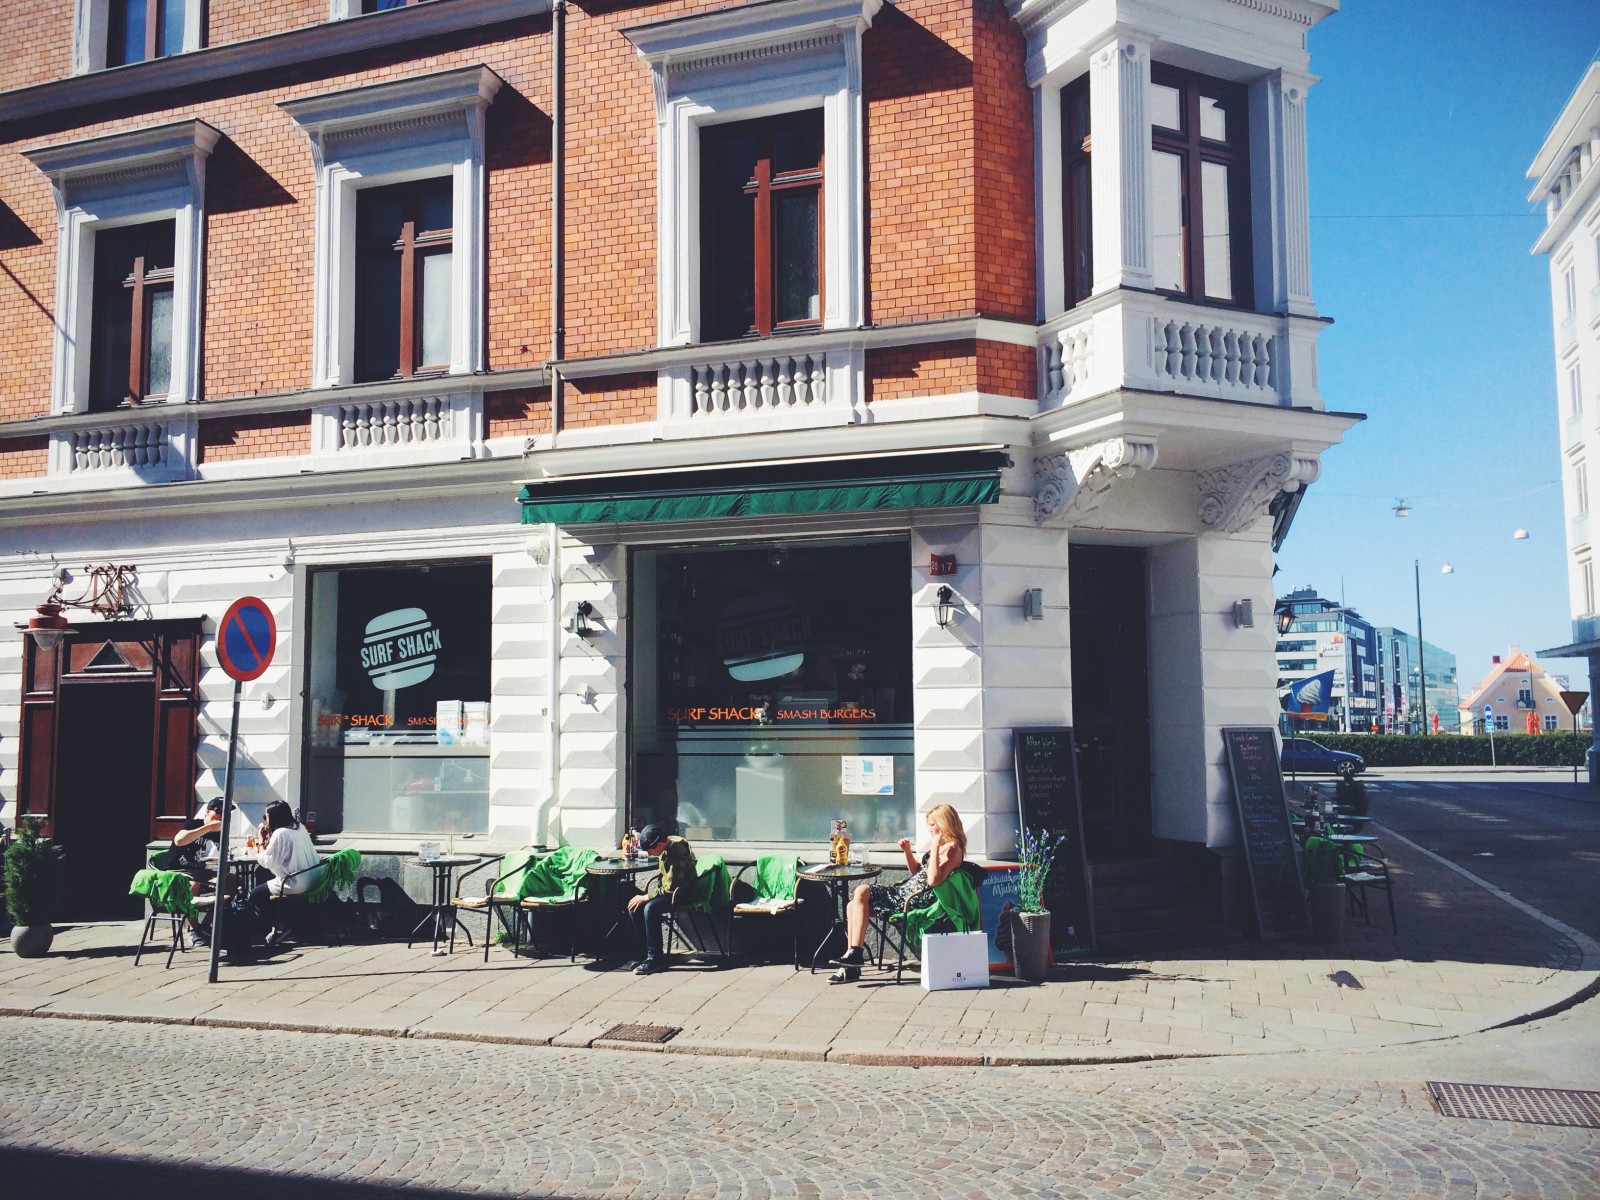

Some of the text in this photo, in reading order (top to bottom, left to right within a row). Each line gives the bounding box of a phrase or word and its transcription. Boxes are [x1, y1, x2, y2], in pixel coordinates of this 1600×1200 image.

[360, 629, 442, 668] SURF SHACK
[350, 714, 394, 726] SHACK
[667, 707, 876, 720] SURF SHACK SMASH BURGERS
